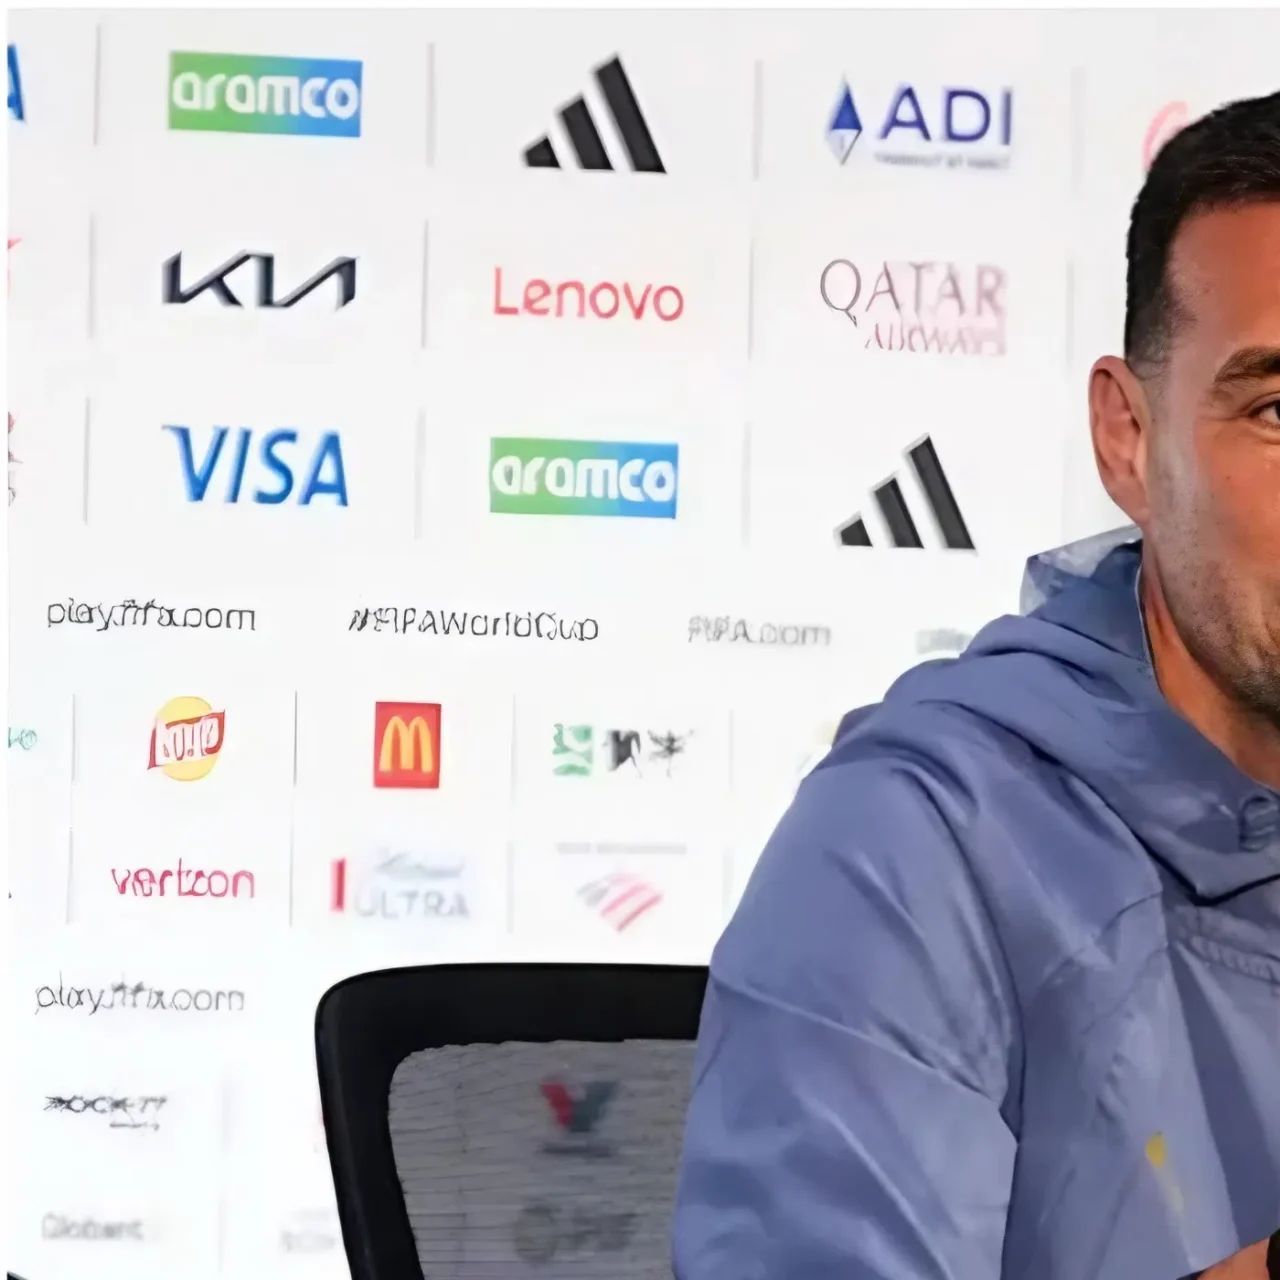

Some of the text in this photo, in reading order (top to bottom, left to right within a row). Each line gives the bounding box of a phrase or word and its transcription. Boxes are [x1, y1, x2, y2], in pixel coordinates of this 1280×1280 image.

[172, 71, 360, 120] aramco
[880, 86, 1013, 147] ADI
[493, 266, 685, 322] Lenovo
[820, 258, 1008, 327] QATAR
[161, 423, 349, 507] VISA
[492, 455, 675, 501] aramco
